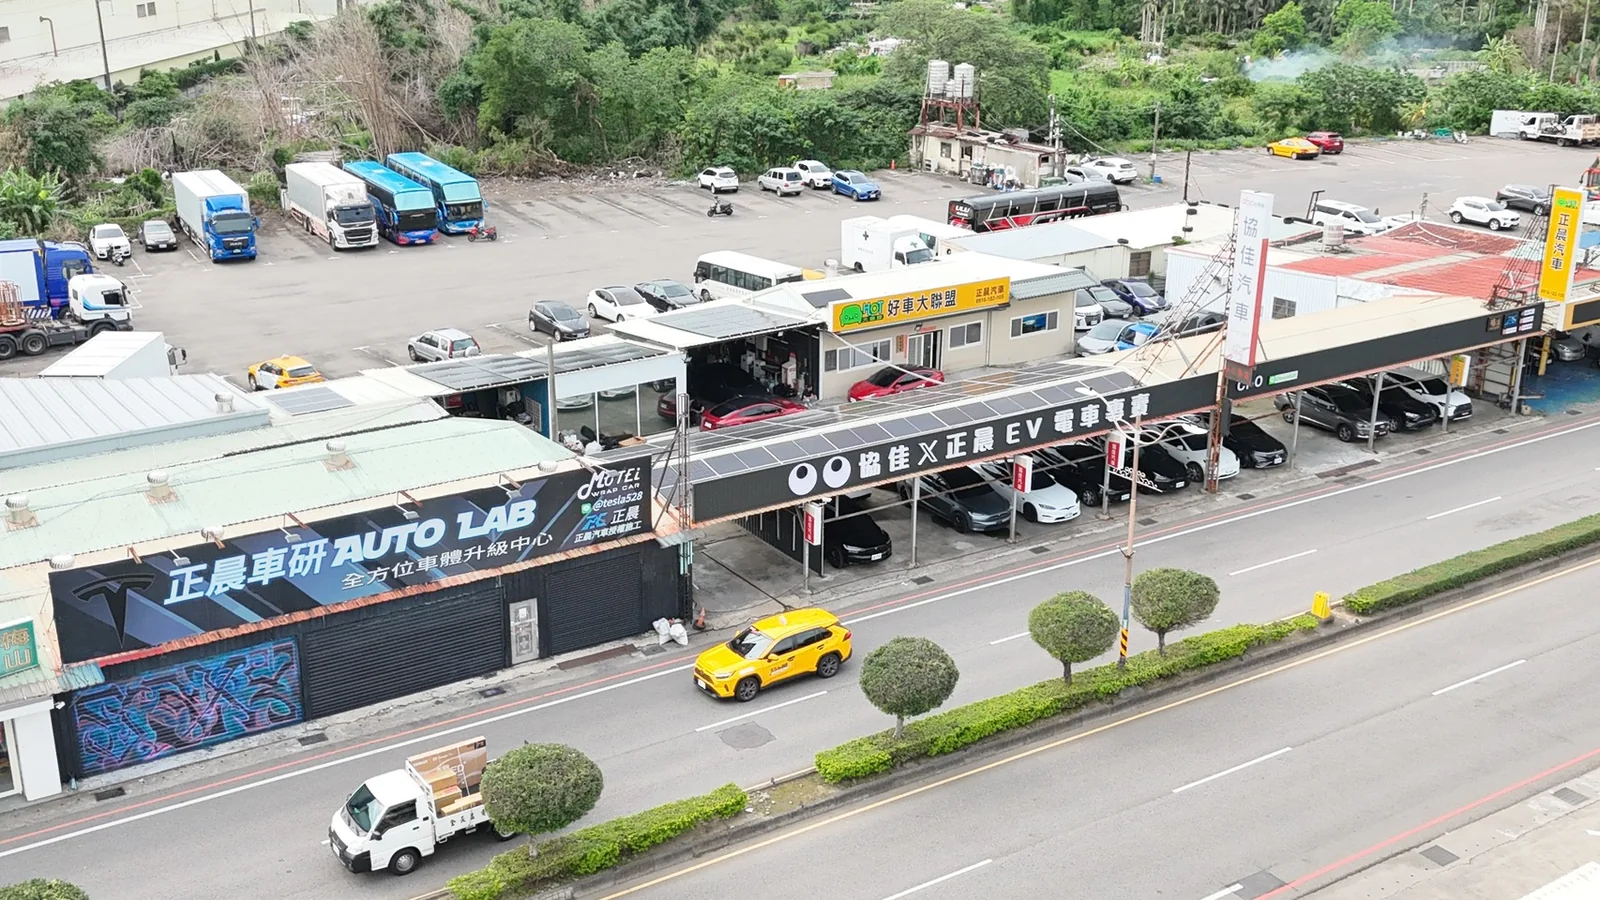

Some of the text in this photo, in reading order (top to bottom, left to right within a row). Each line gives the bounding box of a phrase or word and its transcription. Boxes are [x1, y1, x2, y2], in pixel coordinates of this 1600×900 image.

[1551, 213, 1570, 270] 正晨汽車
[1234, 216, 1258, 321] 協佳汽車
[862, 300, 884, 316] HOT
[887, 290, 956, 317] 好車大聯盟
[858, 444, 910, 479] 協佳
[945, 426, 994, 460] 正晨
[1006, 417, 1043, 444] EV
[591, 482, 640, 497] WRAP CAR
[593, 491, 643, 511] @tesla528
[611, 505, 640, 524] 正晨
[164, 499, 537, 605] 正晨車研 AUTO LAB
[341, 532, 553, 590] 全方位車體升級中心
